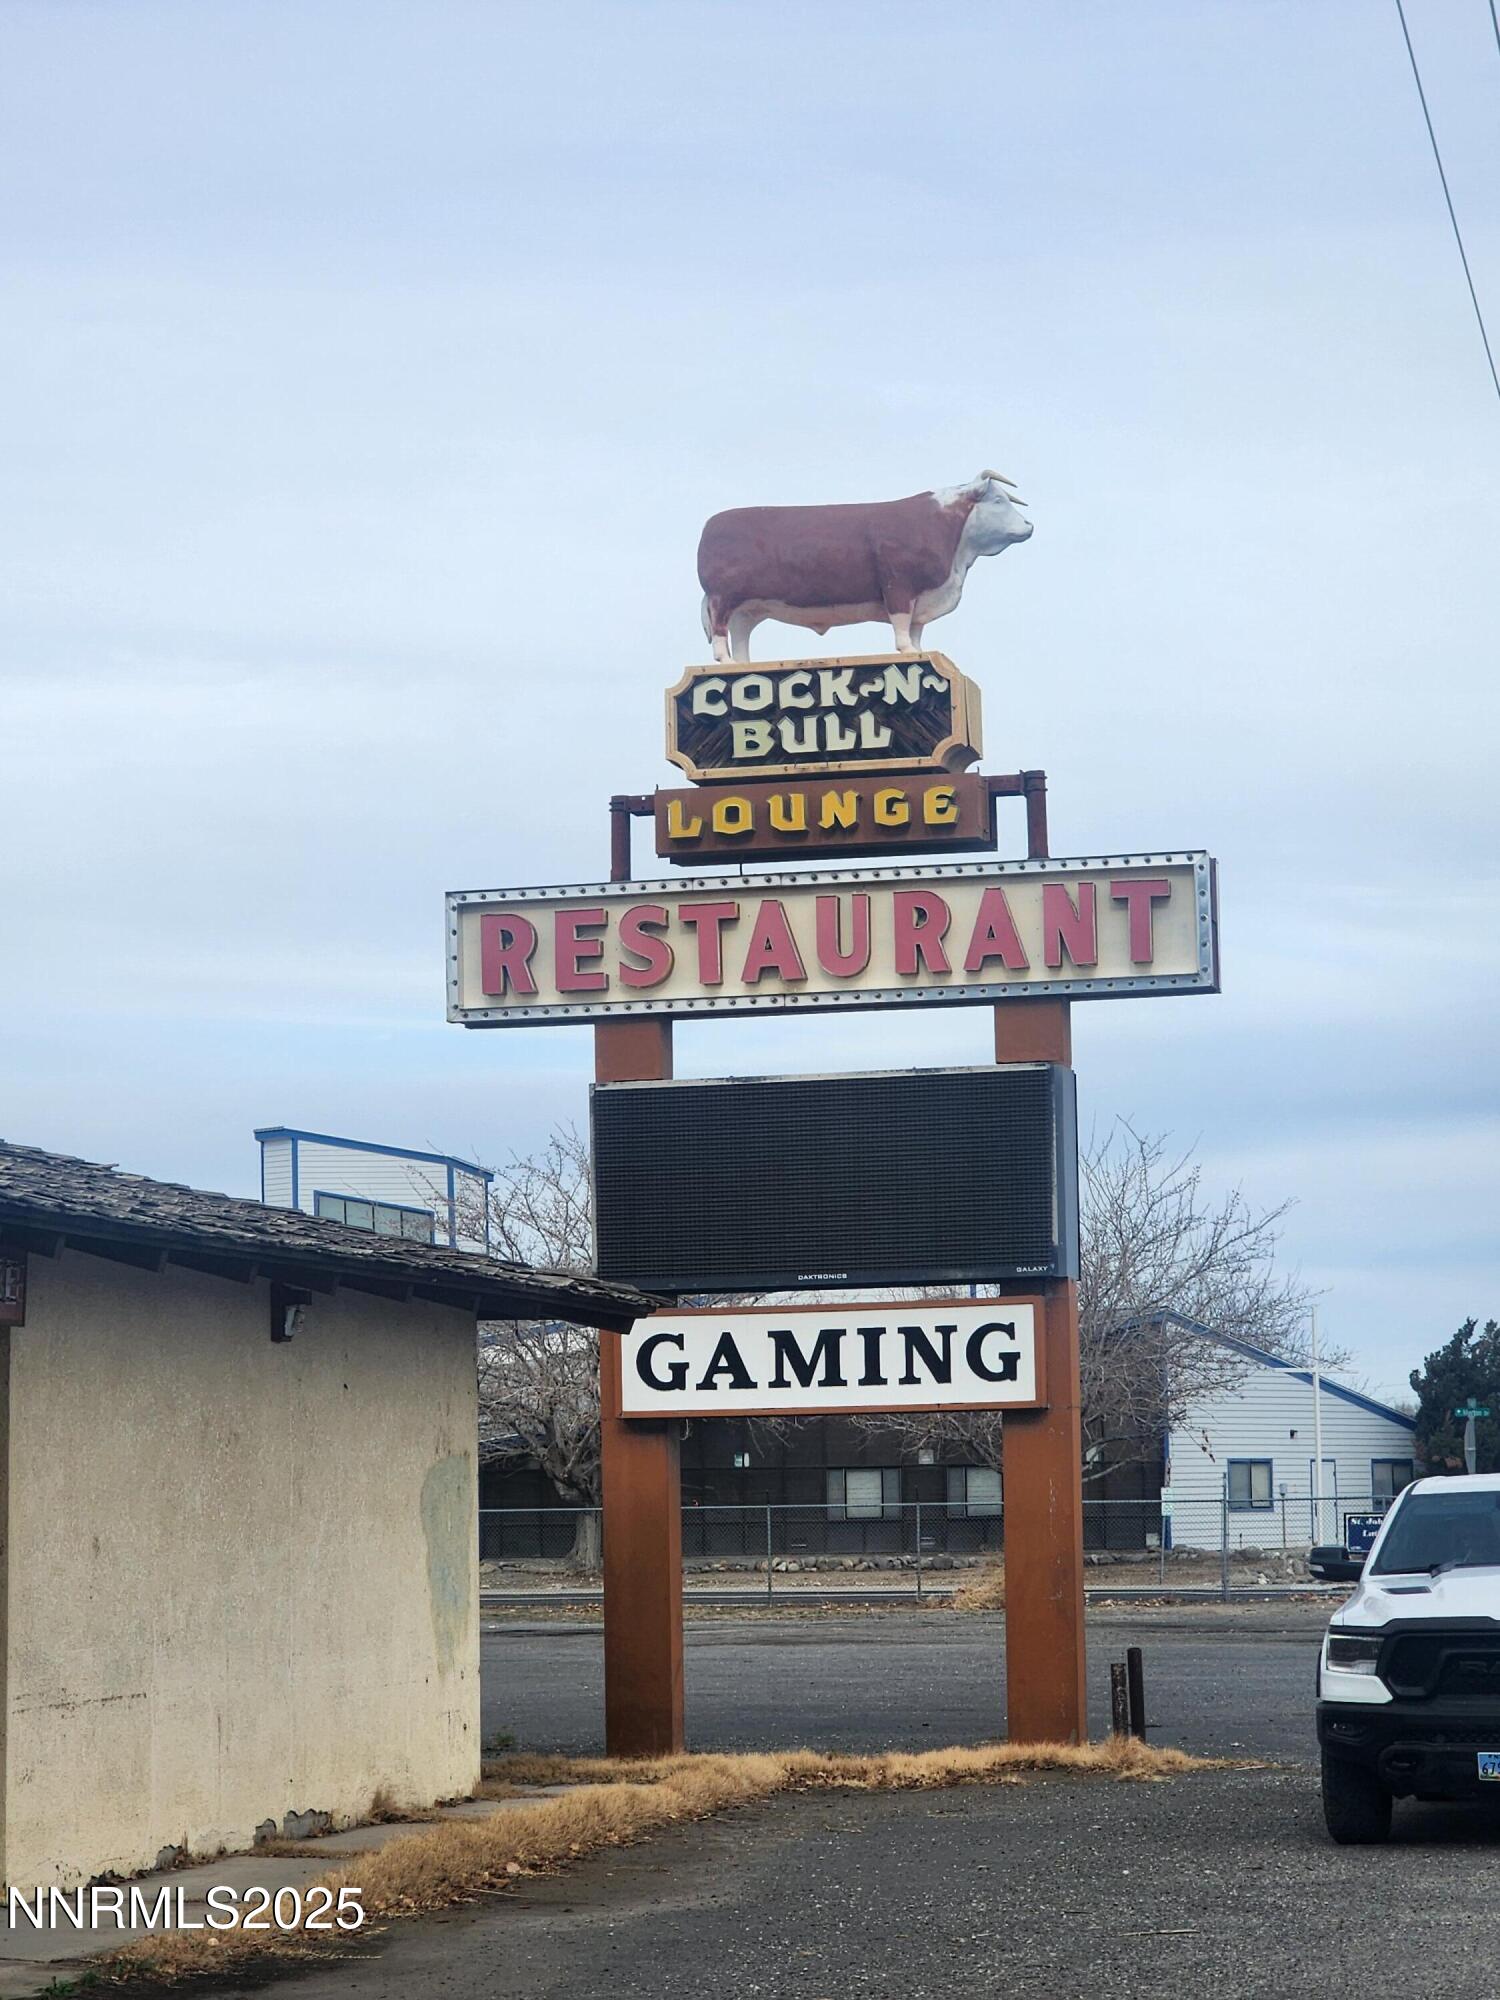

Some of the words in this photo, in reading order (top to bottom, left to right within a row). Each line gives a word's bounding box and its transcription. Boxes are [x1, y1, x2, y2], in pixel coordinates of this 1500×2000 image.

[729, 709, 894, 759] BULL
[667, 785, 962, 839] LOUNGE
[480, 879, 1171, 996] RESTAURANT
[797, 1273, 848, 1281] DAKTRONICS
[1016, 1265, 1049, 1273] GALAXY
[635, 1321, 1021, 1392] GAMING
